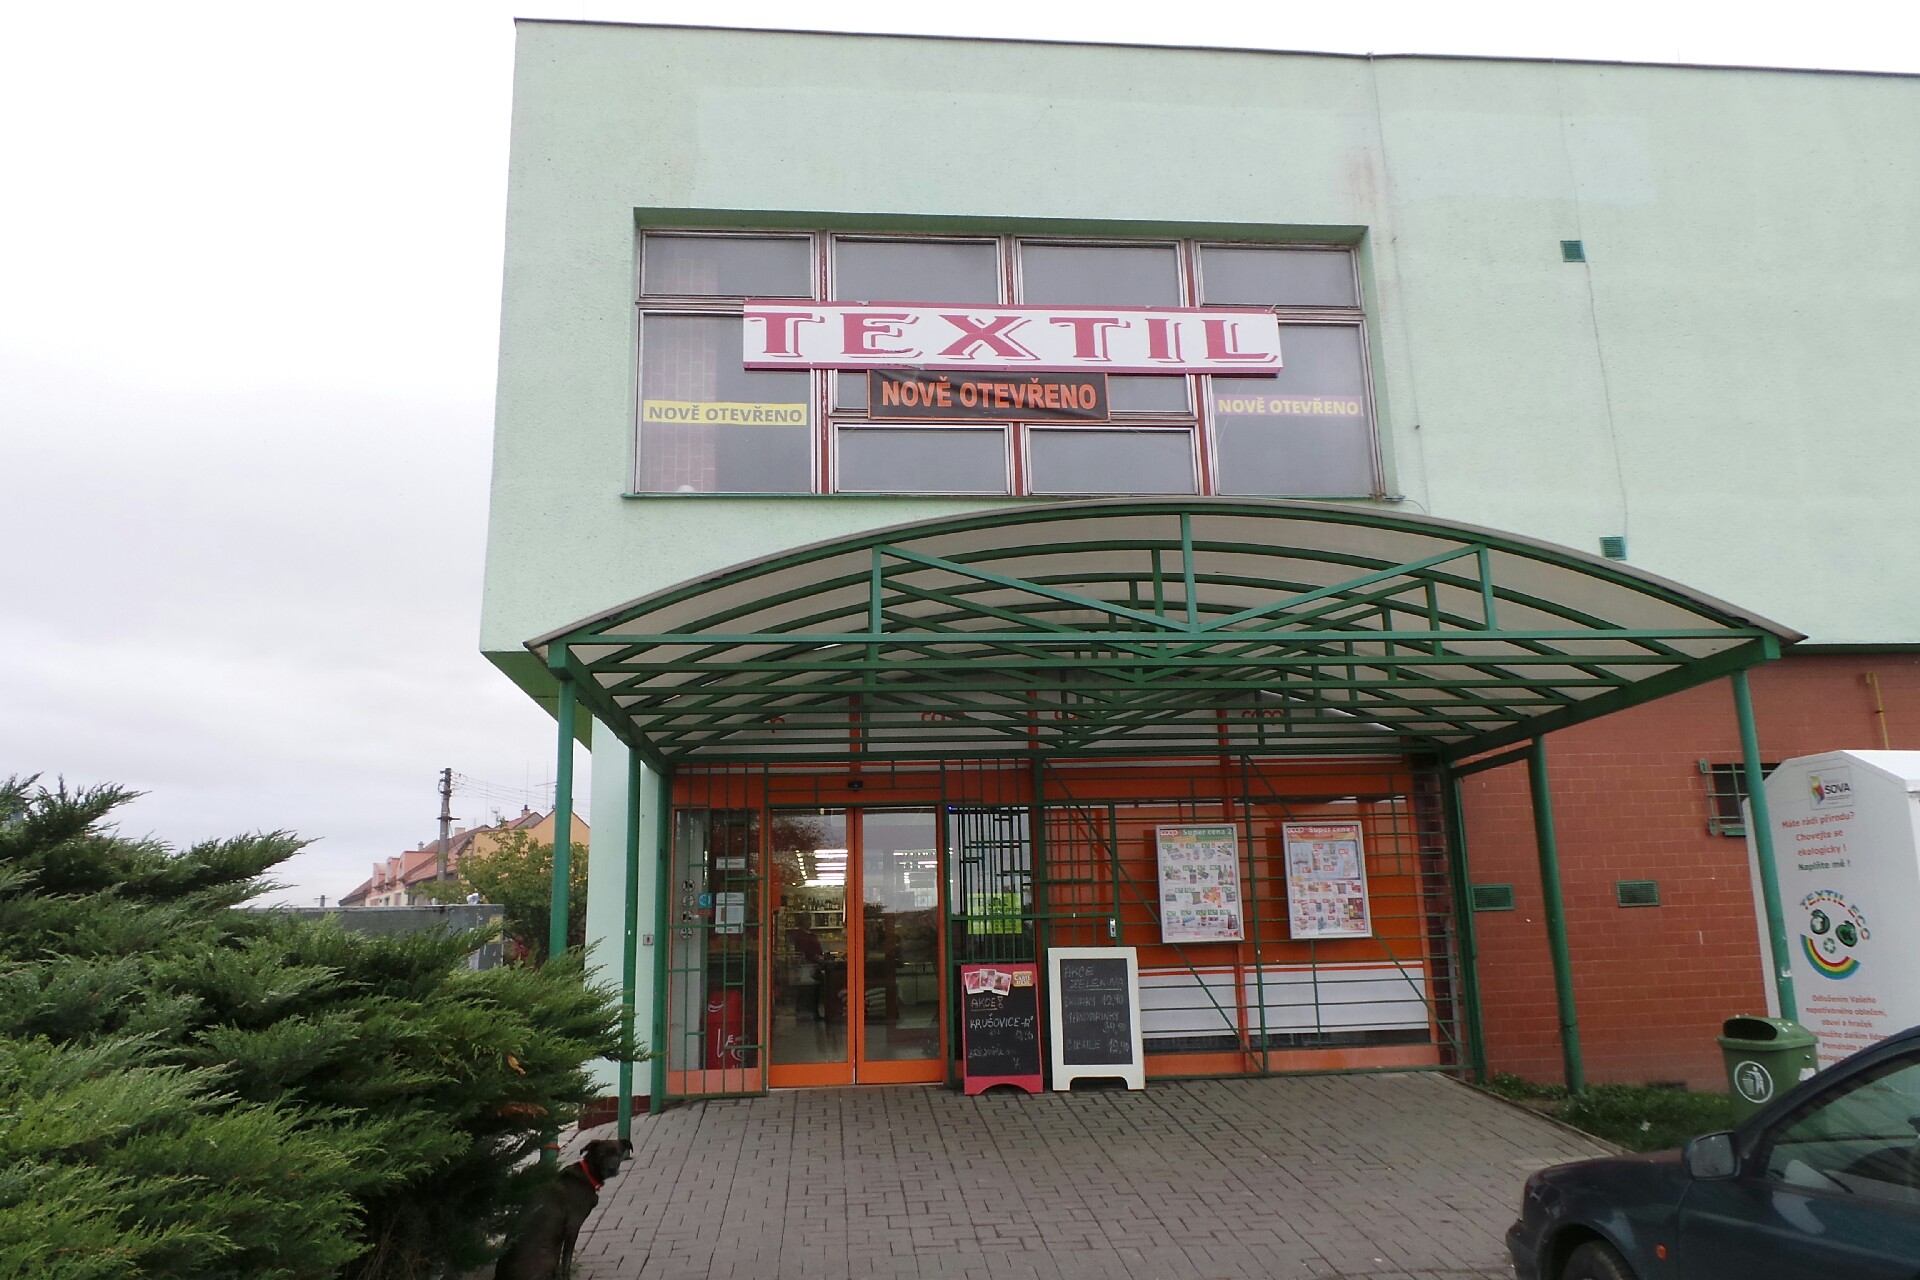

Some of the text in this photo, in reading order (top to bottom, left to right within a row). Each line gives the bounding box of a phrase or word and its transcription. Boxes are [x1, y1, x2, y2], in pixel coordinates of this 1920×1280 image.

[746, 311, 1279, 364] TEXTIL
[881, 376, 1097, 410] NOVĚ OTEVŘENO
[648, 404, 803, 423] NOVĚ OTEVŘENO
[1217, 396, 1360, 416] NOVĚ OTEVŘENO
[1824, 782, 1851, 795] SOVA
[1182, 829, 1206, 837] Super
[1308, 826, 1331, 834] Super
[1799, 888, 1871, 941] TEXTIL ECO
[969, 1012, 1020, 1030] KRUŠOVICE
